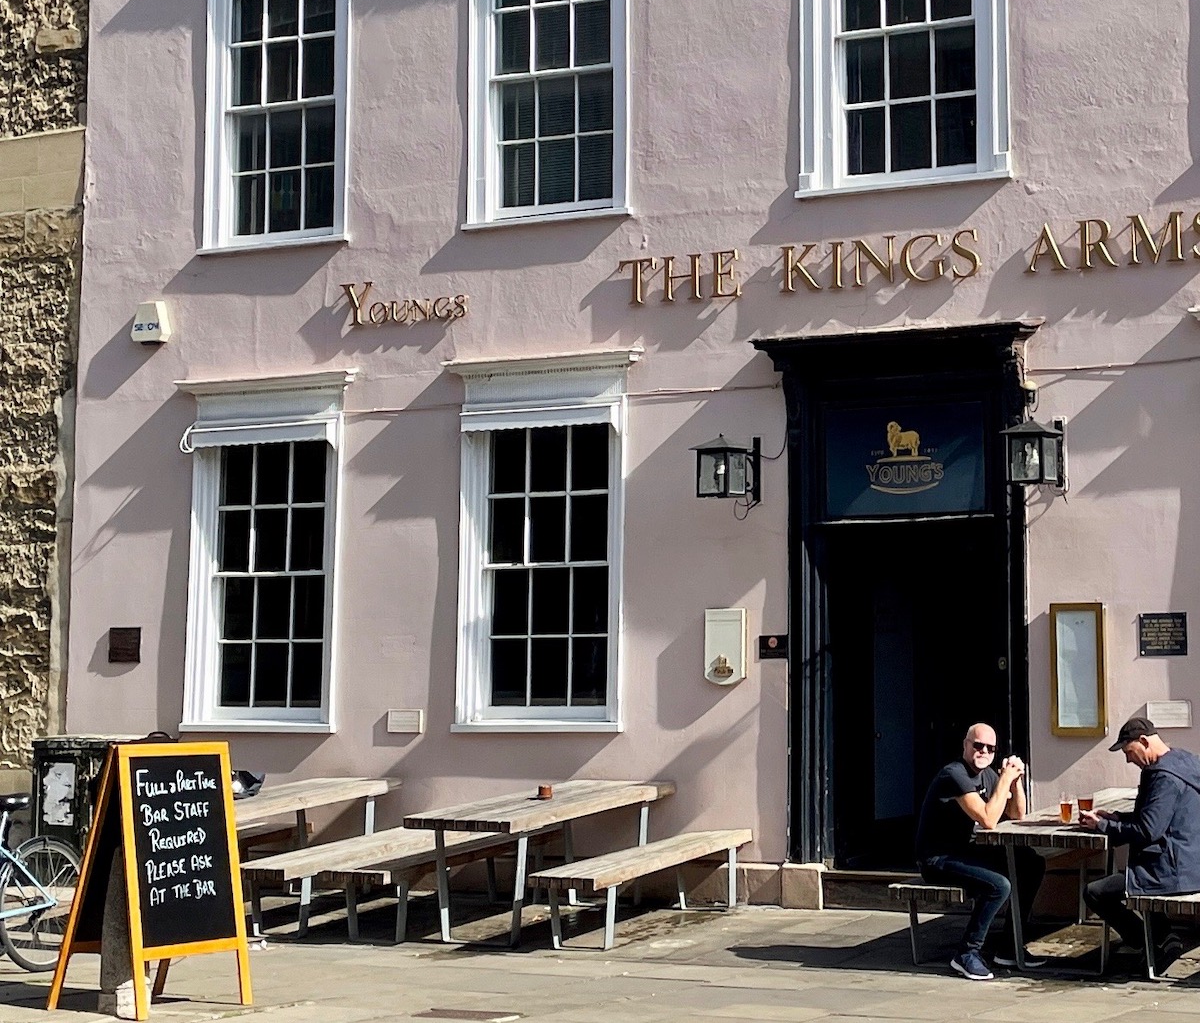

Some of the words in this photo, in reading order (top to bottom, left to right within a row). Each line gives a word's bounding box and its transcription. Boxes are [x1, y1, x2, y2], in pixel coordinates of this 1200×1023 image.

[618, 248, 742, 306] THE
[779, 229, 982, 292] KINGS
[339, 281, 469, 326] YOUNGS
[866, 462, 944, 484] YOUNG'S
[135, 769, 168, 797] FULL
[140, 804, 169, 826] BAR
[174, 801, 209, 821] STAFF
[149, 827, 207, 852] REQUIRED
[145, 858, 186, 884] PLEASE
[191, 854, 213, 872] ASK
[150, 887, 167, 906] AT
[171, 883, 192, 899] THE
[192, 879, 217, 900] BAR
